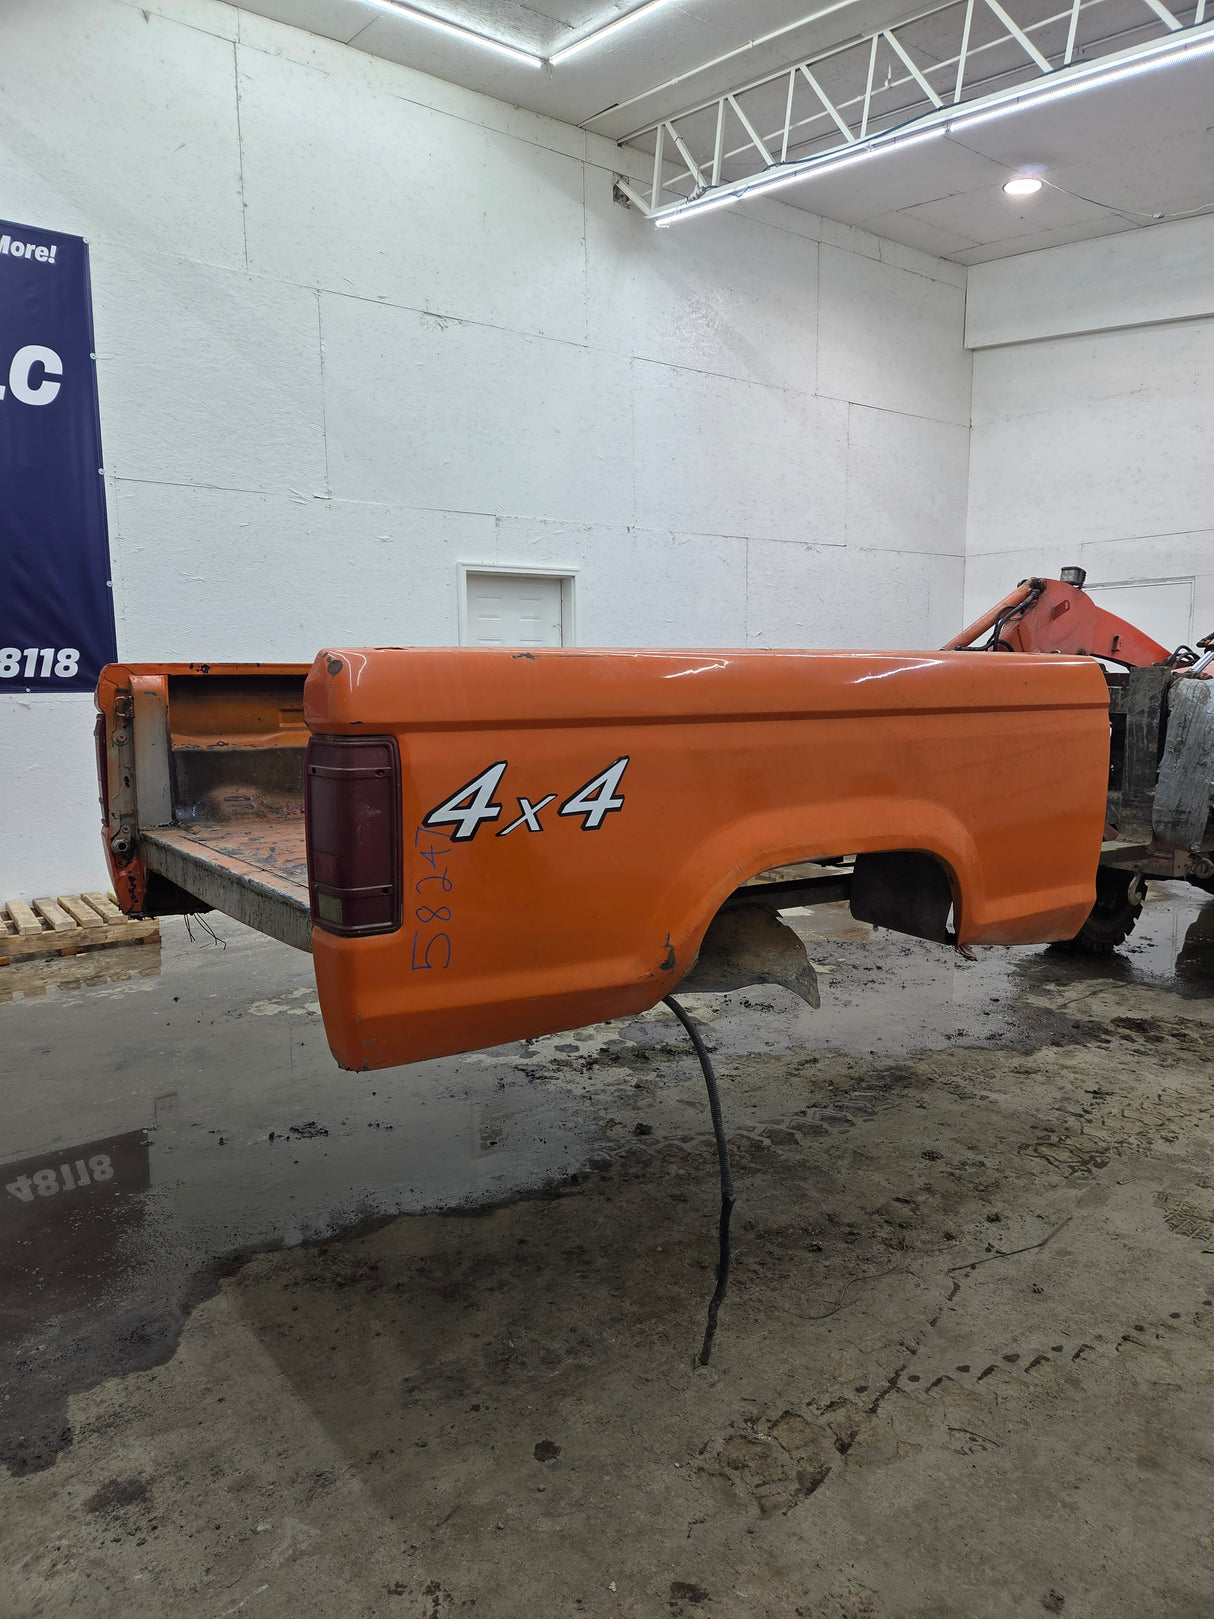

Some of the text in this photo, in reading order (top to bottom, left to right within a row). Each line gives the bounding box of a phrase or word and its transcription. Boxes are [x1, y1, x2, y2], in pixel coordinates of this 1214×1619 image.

[0, 345, 63, 406] C
[0, 647, 80, 678] 8118
[411, 826, 453, 971] 58247
